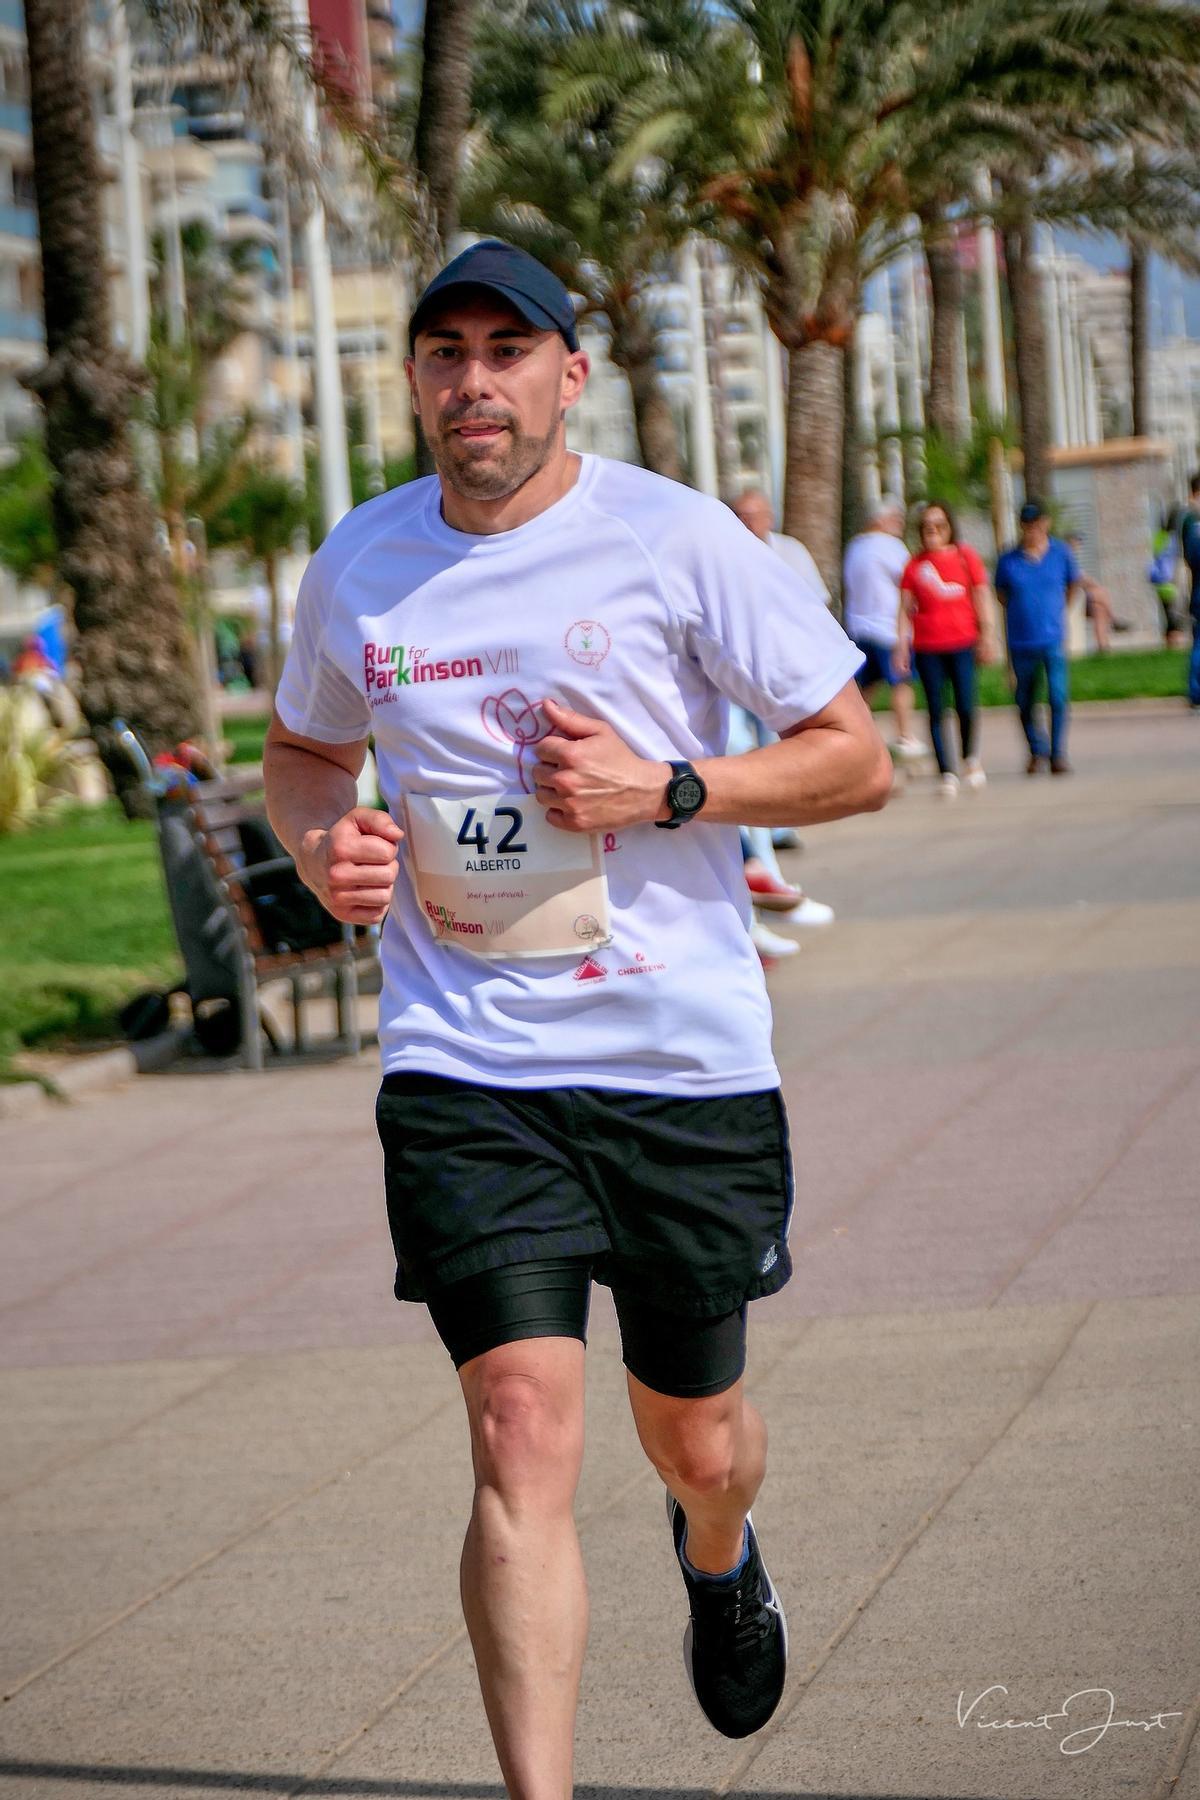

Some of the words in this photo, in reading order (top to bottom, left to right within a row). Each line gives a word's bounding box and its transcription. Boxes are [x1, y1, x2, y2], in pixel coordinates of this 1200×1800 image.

[365, 643, 404, 667] Run
[408, 646, 430, 660] for
[365, 656, 483, 692] Parkinson
[484, 648, 519, 674] VIII
[457, 806, 528, 854] 42
[465, 858, 521, 872] ALBERTO
[425, 901, 448, 917] Run
